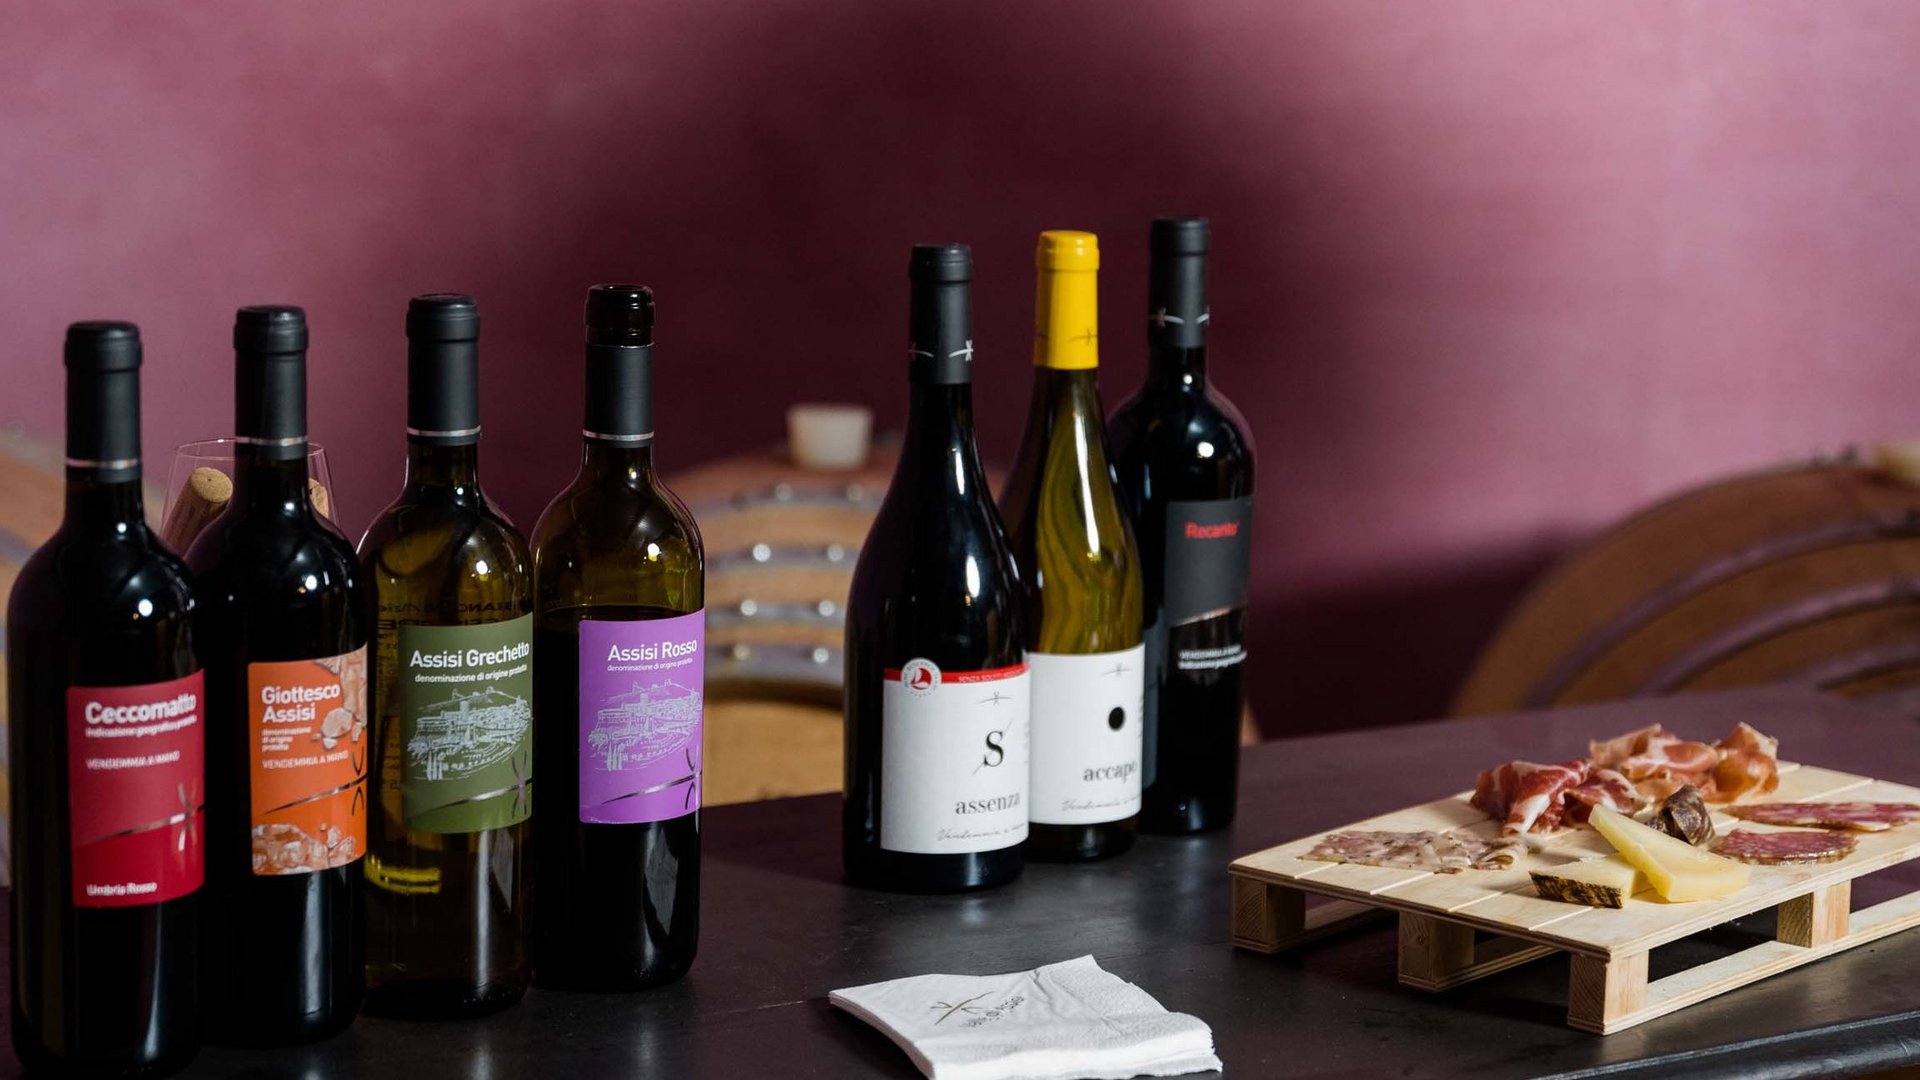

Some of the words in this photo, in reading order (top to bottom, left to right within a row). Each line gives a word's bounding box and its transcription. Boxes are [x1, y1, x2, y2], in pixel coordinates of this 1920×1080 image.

[410, 649, 462, 668] Assisi
[466, 641, 530, 667] Grechetto
[607, 643, 658, 661] Assisi
[661, 640, 697, 659] Rosso
[415, 673, 476, 683] denominazione
[477, 671, 484, 681] di
[485, 668, 508, 681] origine
[261, 684, 340, 704] Giottesco
[85, 693, 196, 724] Ceccomatto
[262, 702, 316, 723] Assisi
[983, 730, 1004, 767] S
[86, 757, 147, 770] VENDEMMIA
[262, 756, 318, 769] VENDEMMIA
[955, 792, 1021, 815] assenza
[86, 884, 126, 896] Umbria
